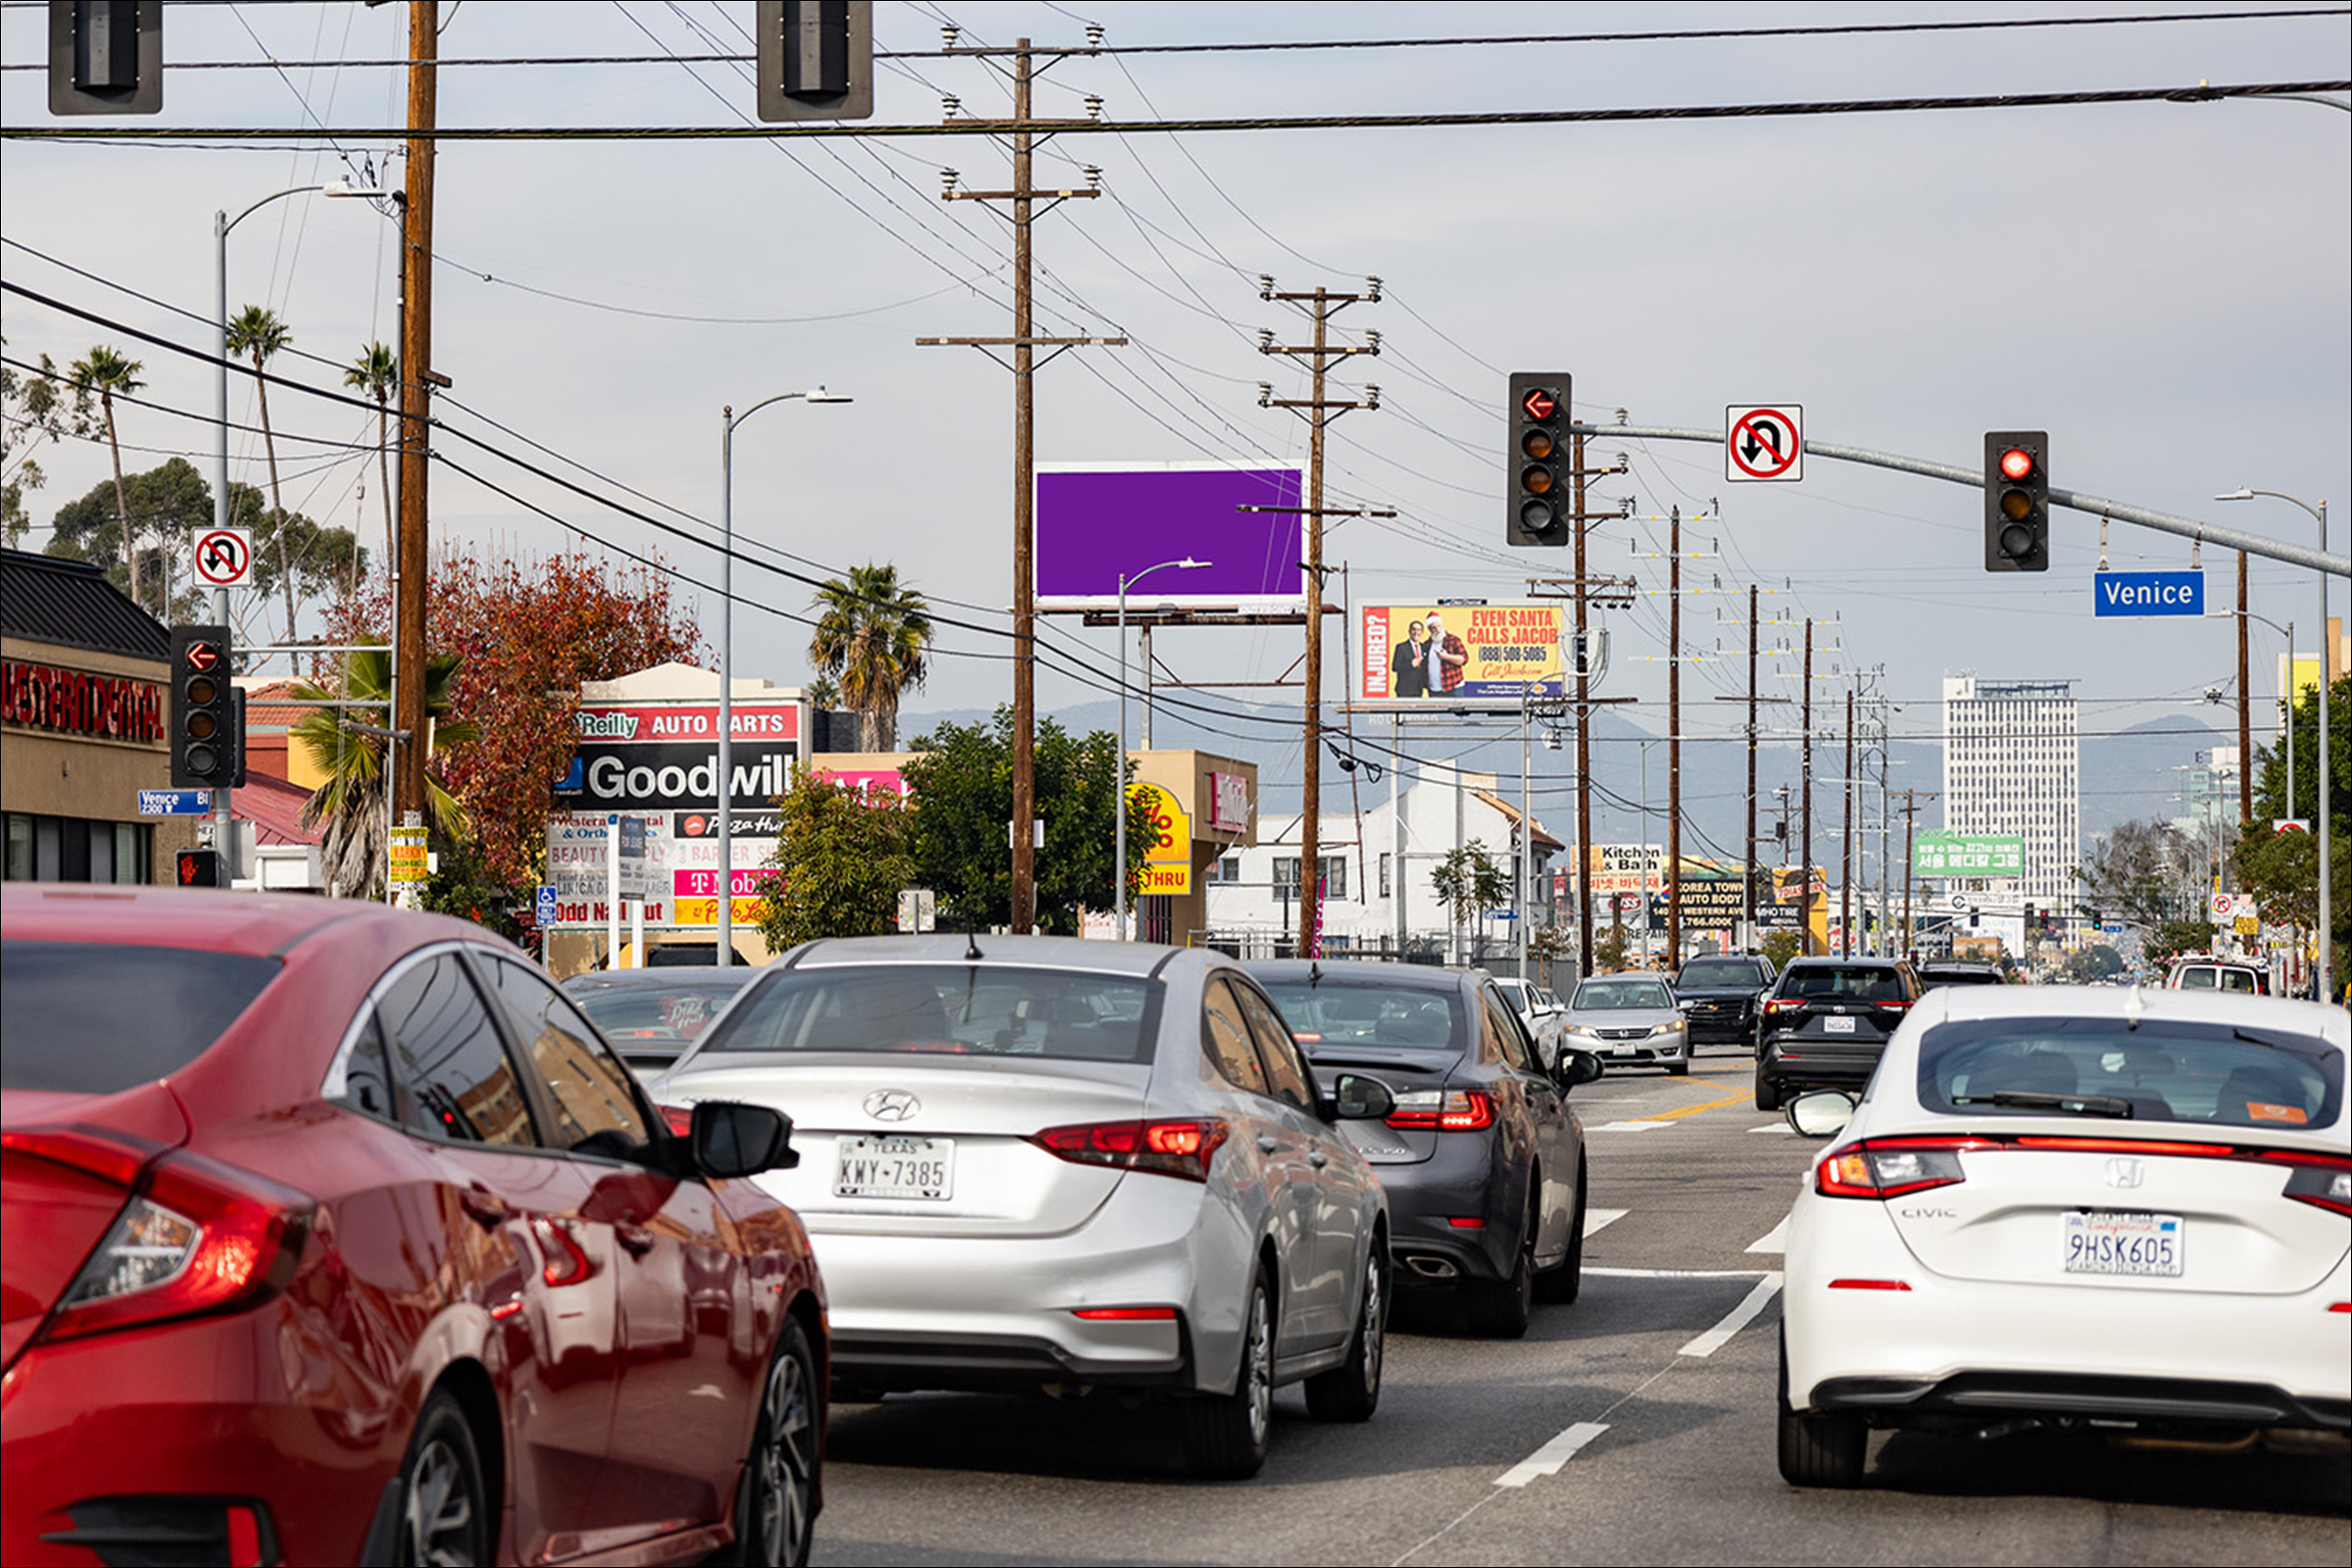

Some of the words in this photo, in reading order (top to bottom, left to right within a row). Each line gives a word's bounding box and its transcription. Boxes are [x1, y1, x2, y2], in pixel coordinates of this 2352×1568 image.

[2104, 581, 2193, 605] Venice
[1472, 611, 1506, 626] EVEN
[1509, 611, 1552, 626] SANTA
[1467, 628, 1510, 644] CALLS
[1512, 628, 1558, 644] JACOB
[1367, 614, 1387, 692] INJURED?
[1479, 646, 1501, 662] (888)
[93, 676, 165, 740] DENTAL
[652, 715, 708, 734] AUTO
[589, 755, 793, 799] Goodwill
[142, 791, 179, 805] Venice
[197, 791, 209, 805] Bl
[563, 829, 573, 839] &
[552, 847, 608, 862] BEAUTY
[692, 845, 750, 861] BARER
[1619, 859, 1657, 870] Bah
[1919, 854, 1944, 869] 서울
[1993, 854, 2020, 868] 그룹
[1146, 872, 1185, 887] THRU
[551, 882, 594, 895] LINICA
[1680, 895, 1709, 905] AUTO
[1712, 895, 1741, 905] BODY
[556, 903, 587, 921] Odd
[1684, 906, 1726, 915] WESTERN
[1779, 907, 1798, 916] TIRE
[874, 1144, 917, 1154] TEXAS
[1901, 1208, 1957, 1218] CIVIC
[2071, 1234, 2174, 1264] 9HSK605
